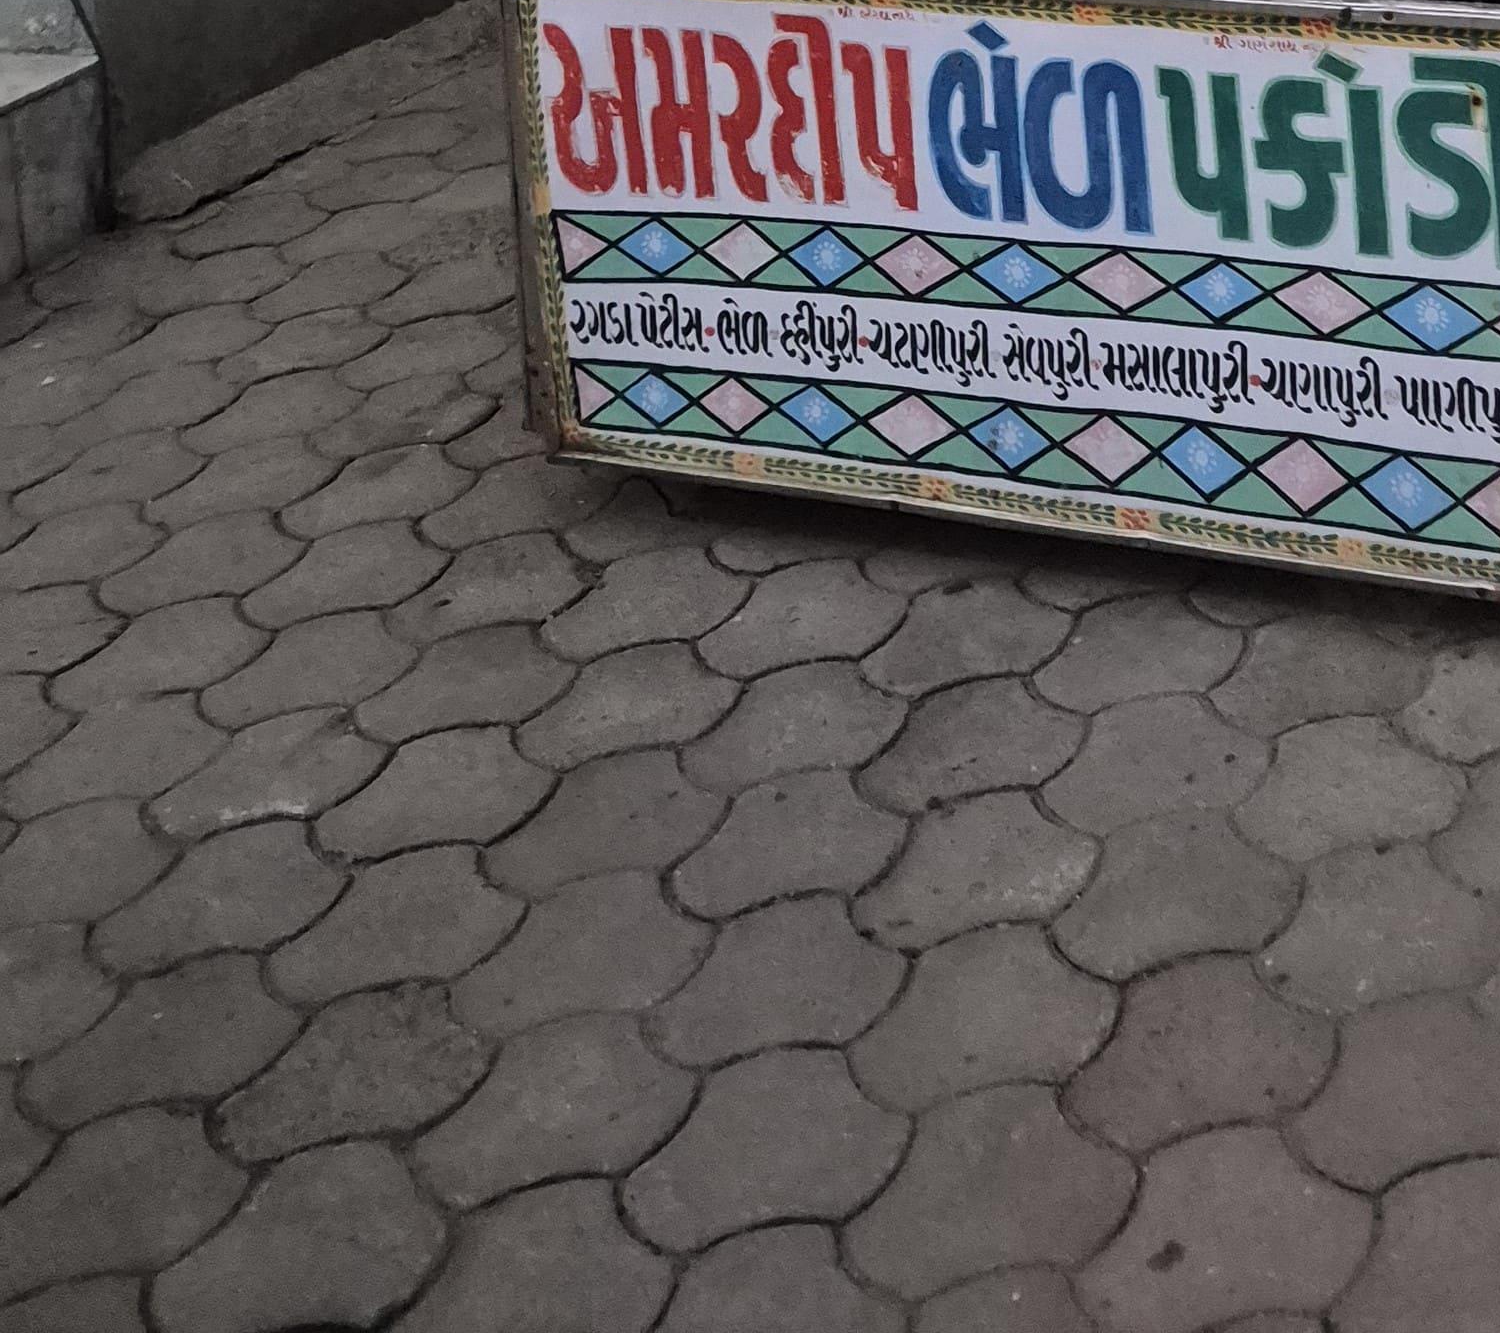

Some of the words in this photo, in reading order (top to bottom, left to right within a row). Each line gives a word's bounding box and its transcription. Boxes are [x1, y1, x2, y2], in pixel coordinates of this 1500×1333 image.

[542, 13, 919, 212] અમરદીપ
[927, 20, 1155, 235] ભેળ
[717, 297, 774, 358] ભેળ
[1002, 323, 1100, 401] સેવપુરી
[1100, 340, 1255, 413] મસાલાપુરી
